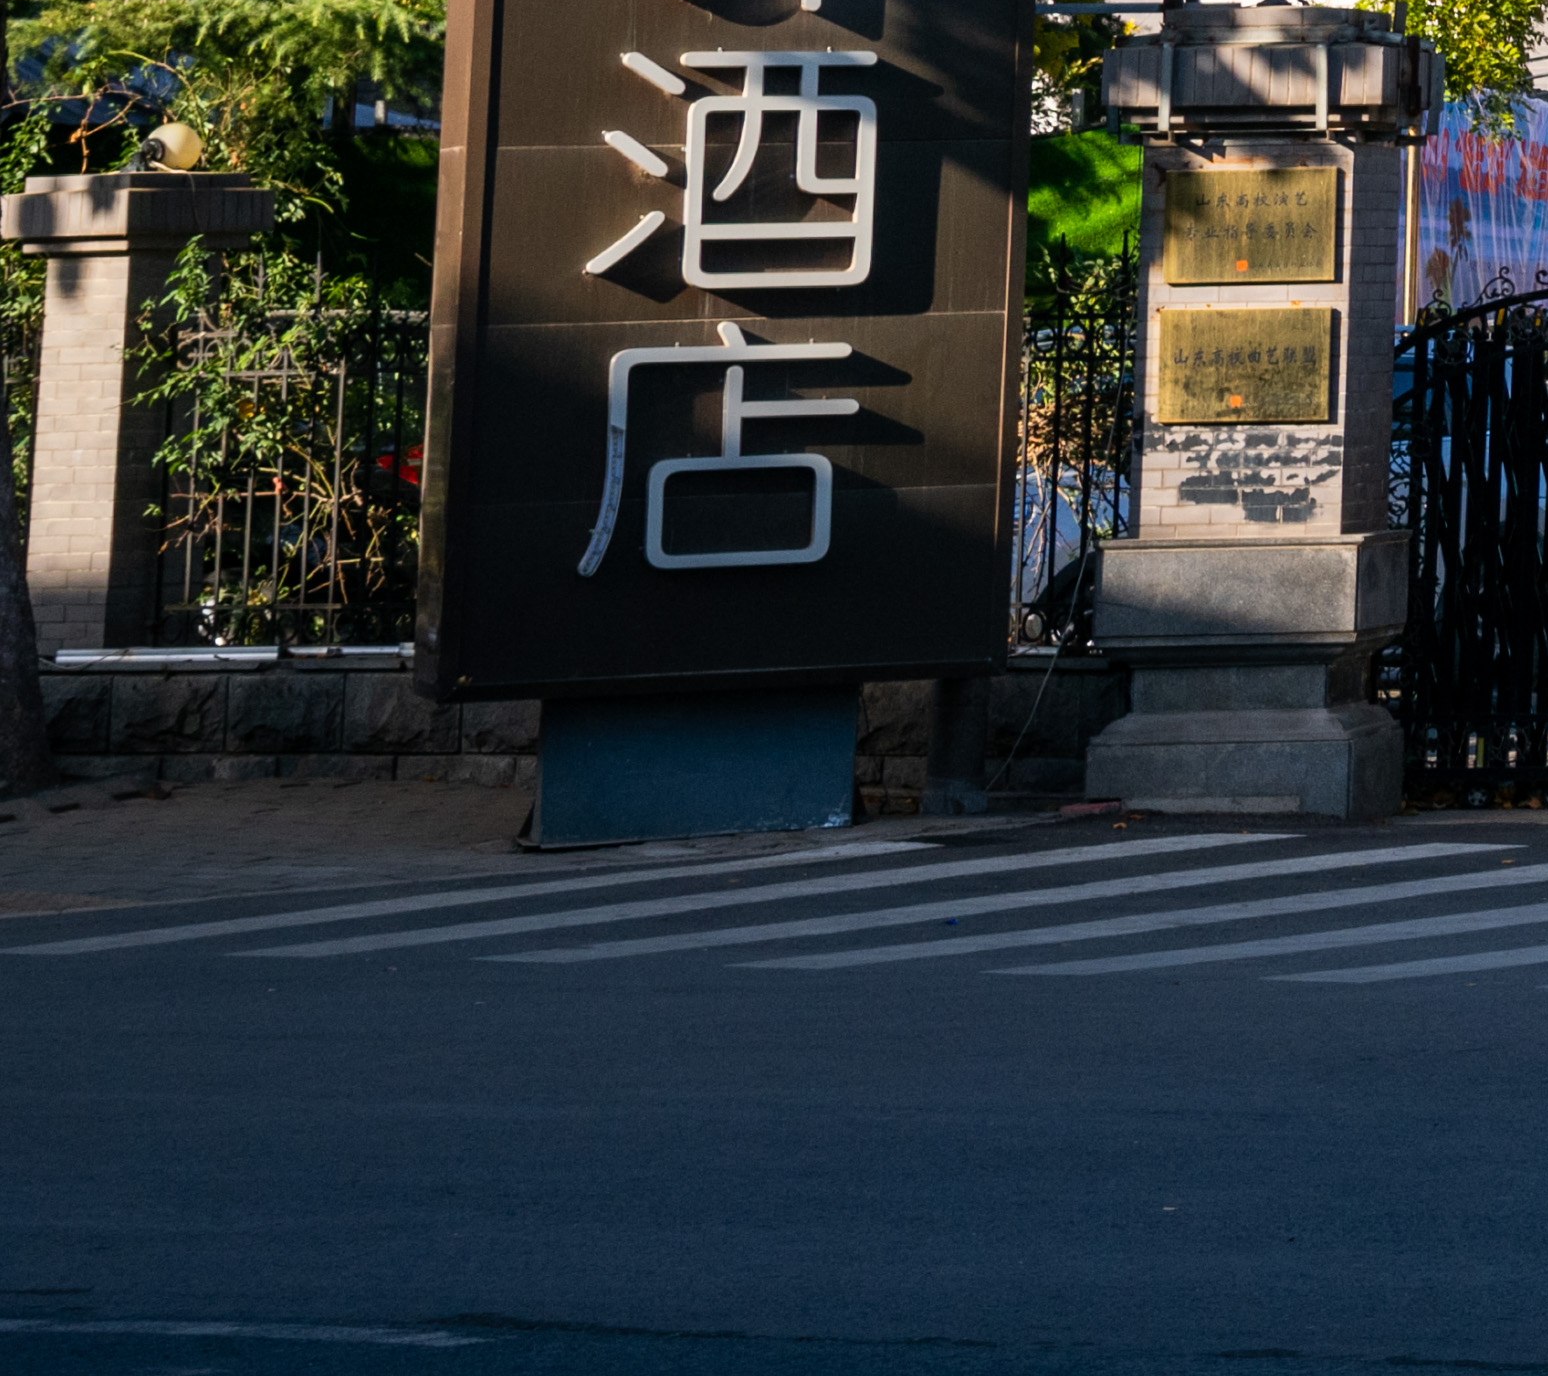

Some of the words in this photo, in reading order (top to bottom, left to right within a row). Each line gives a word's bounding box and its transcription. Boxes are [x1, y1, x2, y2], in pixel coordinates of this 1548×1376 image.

[1195, 191, 1309, 208] 山东高校演艺
